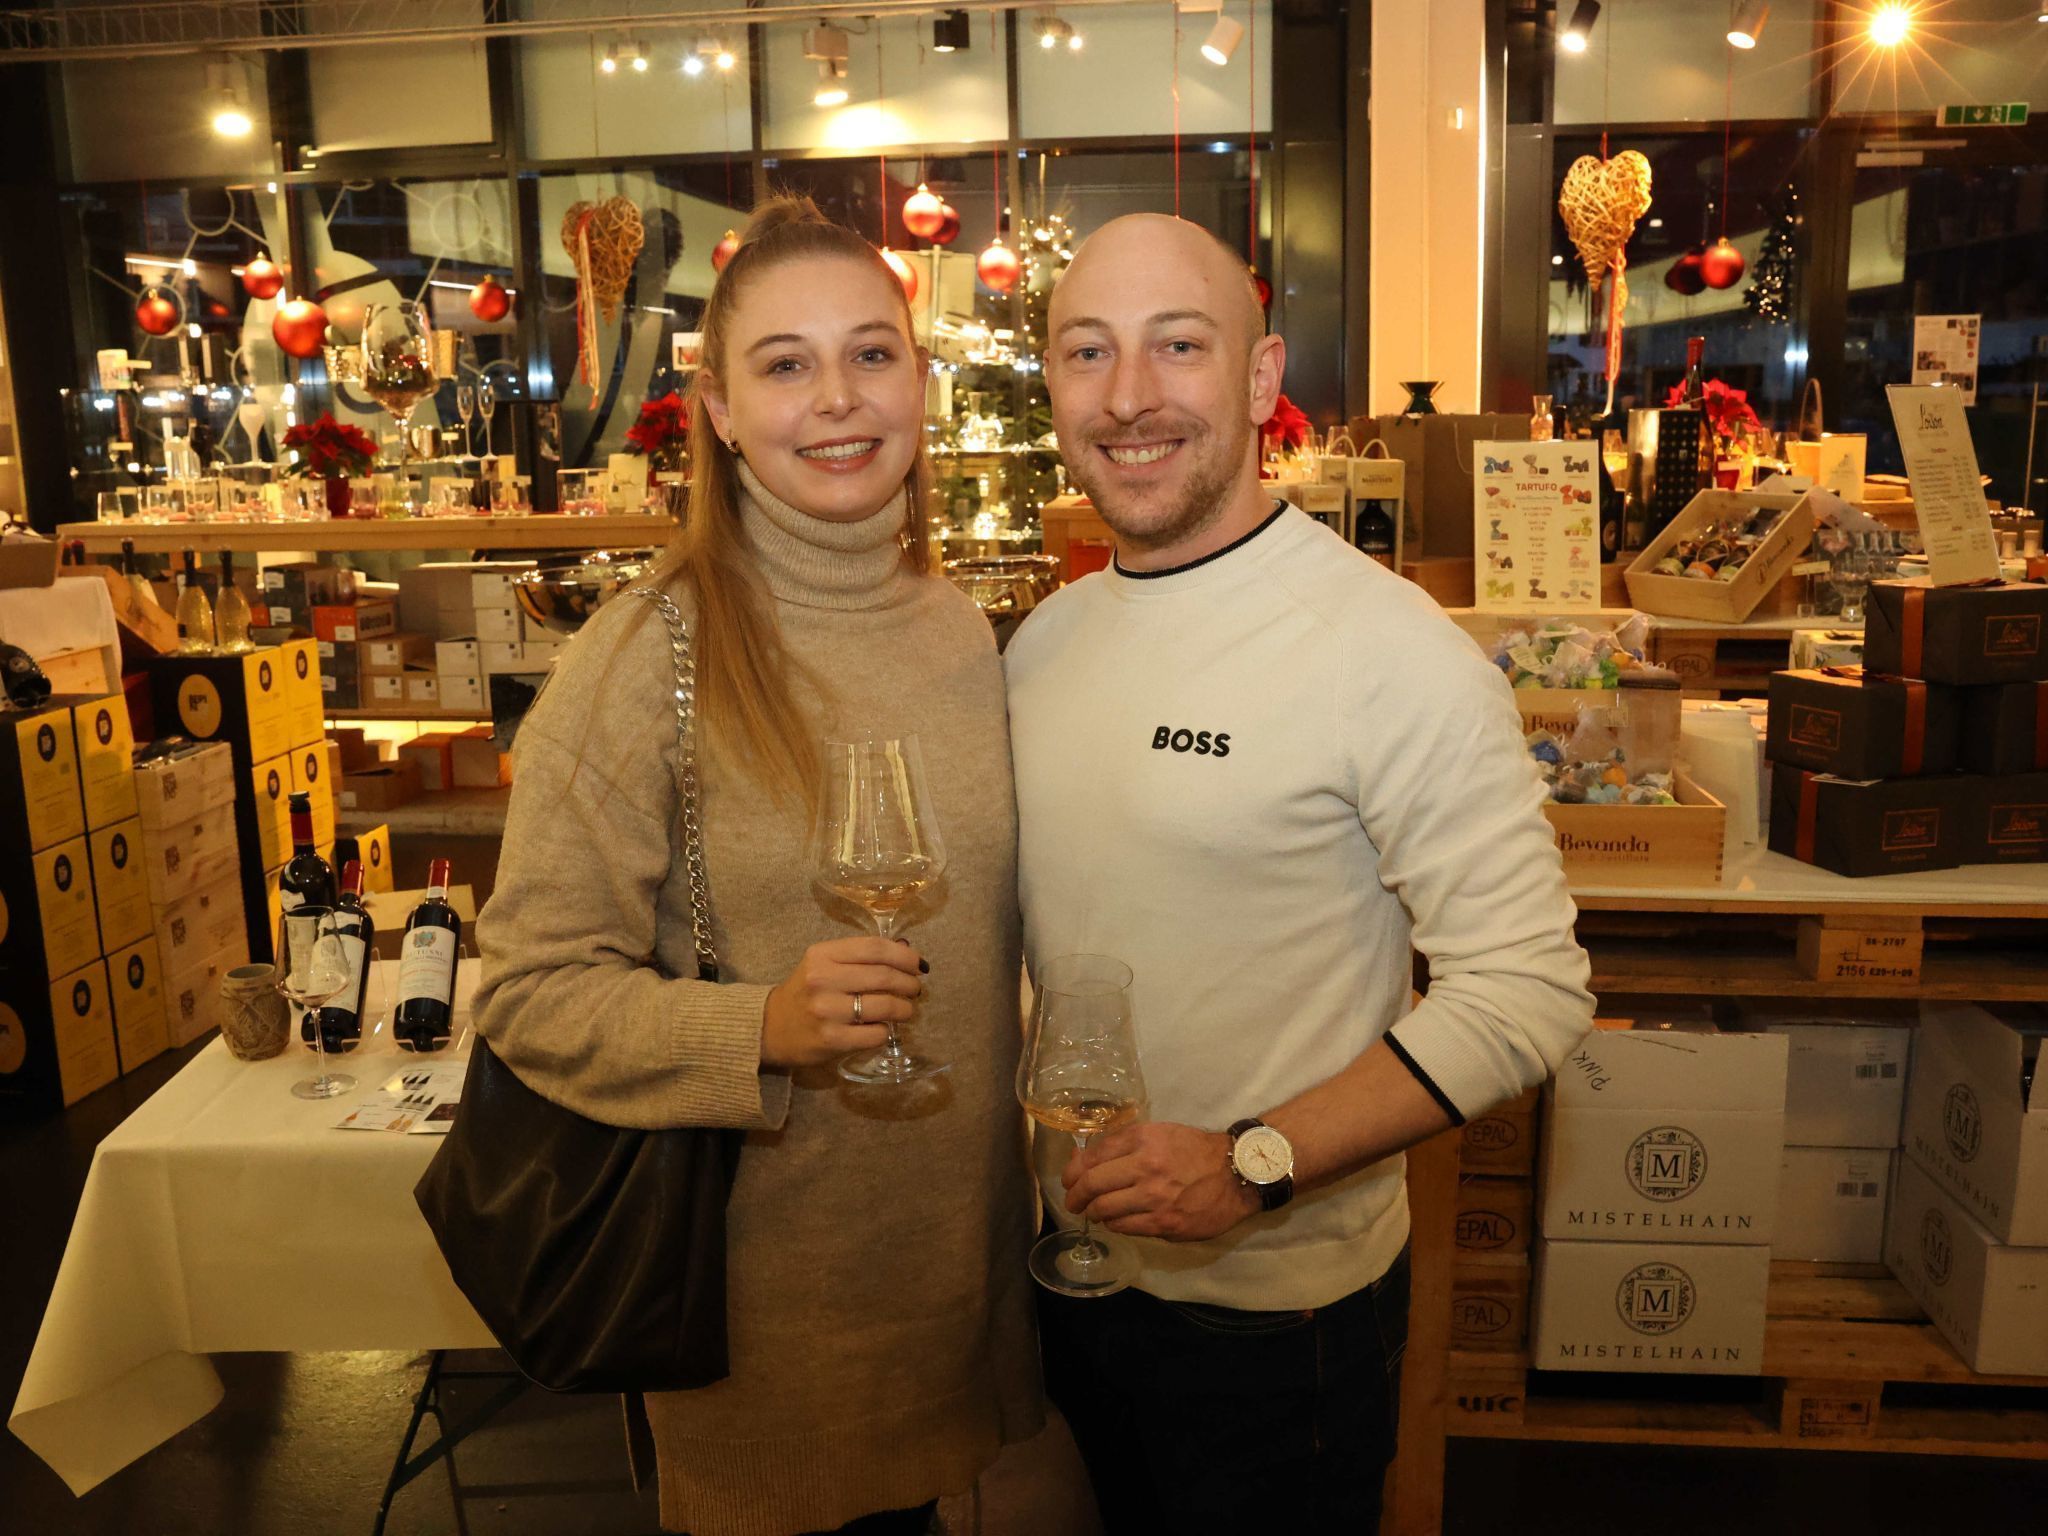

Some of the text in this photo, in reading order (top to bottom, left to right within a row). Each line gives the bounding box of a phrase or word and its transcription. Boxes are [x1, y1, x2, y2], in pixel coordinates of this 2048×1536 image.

[1515, 482, 1559, 492] TARTUFO
[1152, 726, 1231, 757] BOSS
[1559, 832, 1650, 852] Bevanda
[1836, 965, 1866, 977] 2156
[1573, 1051, 1612, 1091] PINK
[1473, 1126, 1509, 1143] EPAL
[1651, 1153, 1681, 1179] M
[1568, 1211, 1753, 1228] MISTELHAIN
[1456, 1219, 1503, 1242] EPAL
[1640, 1288, 1672, 1313] M
[1559, 1344, 1741, 1361] MISTELHAIN
